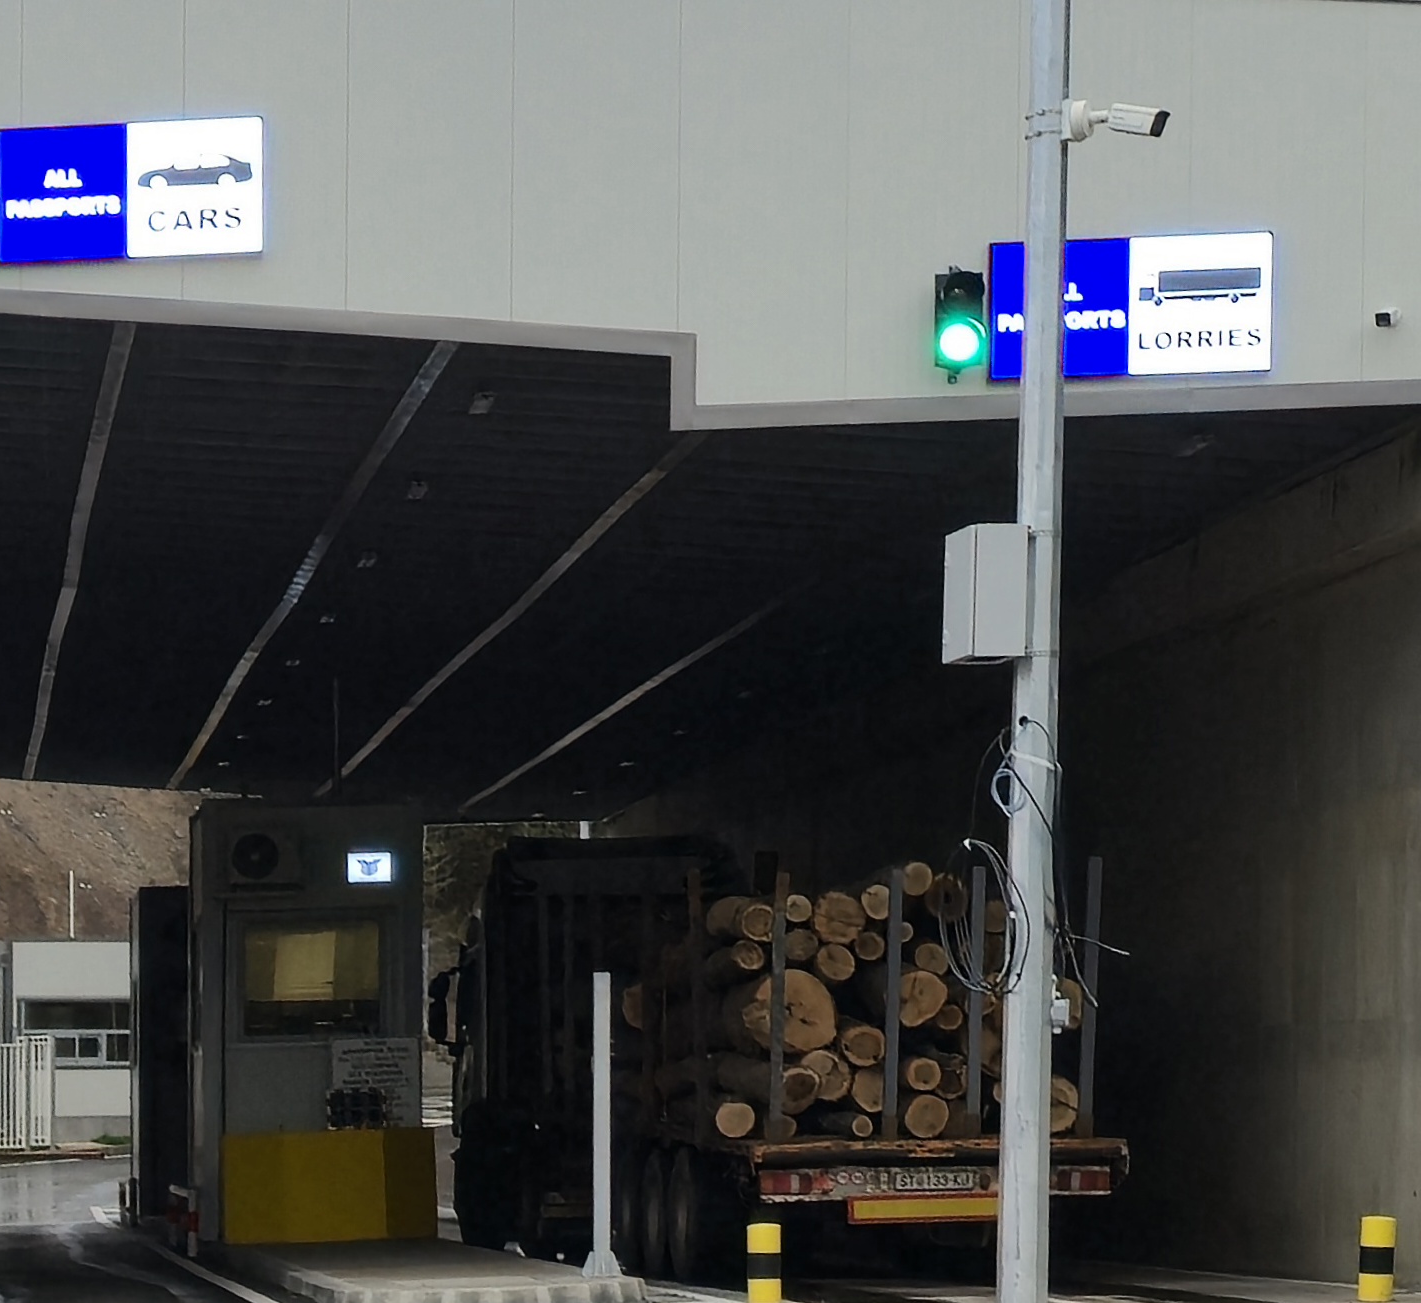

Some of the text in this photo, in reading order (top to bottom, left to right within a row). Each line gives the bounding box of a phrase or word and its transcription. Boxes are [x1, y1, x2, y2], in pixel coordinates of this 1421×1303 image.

[43, 168, 83, 189] ALL
[148, 207, 242, 232] CARS
[997, 309, 1126, 332] PAORTS
[1138, 328, 1262, 350] LORRIES
